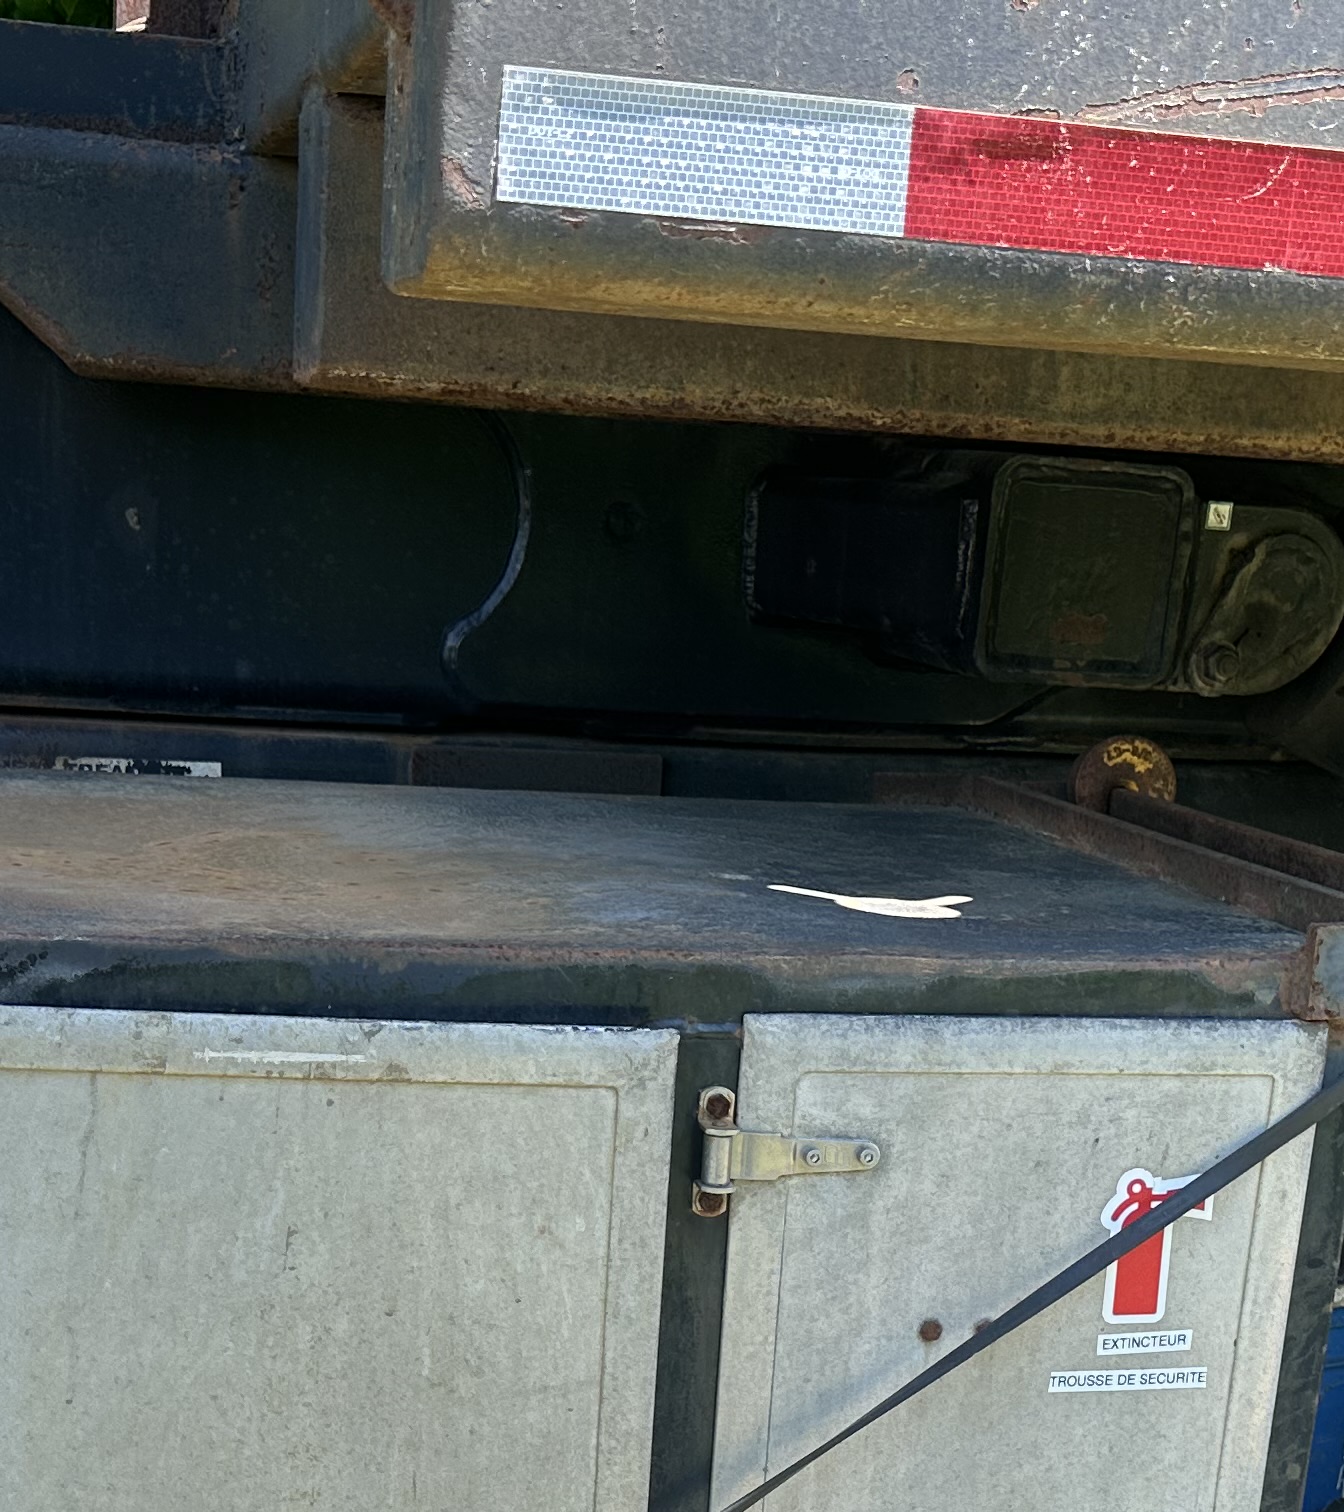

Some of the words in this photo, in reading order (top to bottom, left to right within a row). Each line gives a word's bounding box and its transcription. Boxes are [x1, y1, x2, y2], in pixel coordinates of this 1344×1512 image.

[1102, 1333, 1188, 1350] EXTINCTEUR
[1050, 1374, 1114, 1387] TROUSSE
[1117, 1373, 1137, 1386] DE
[1139, 1371, 1207, 1384] SECURITE
